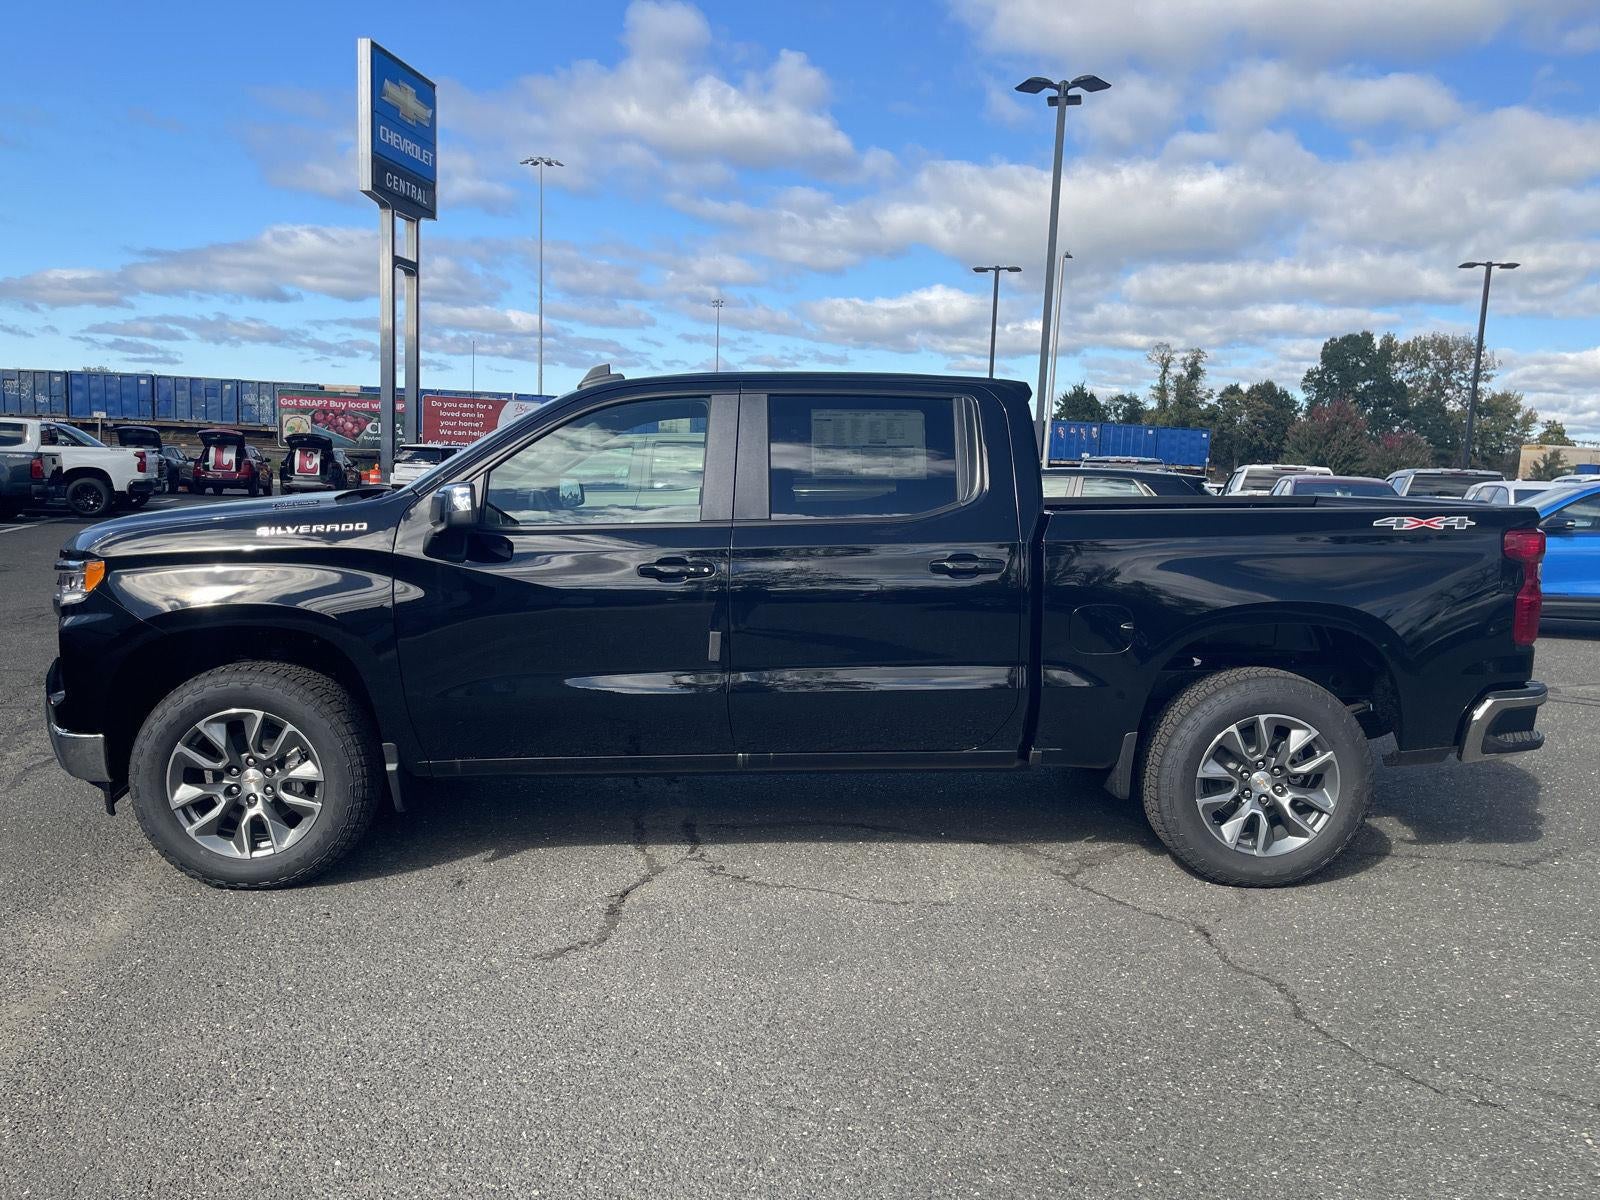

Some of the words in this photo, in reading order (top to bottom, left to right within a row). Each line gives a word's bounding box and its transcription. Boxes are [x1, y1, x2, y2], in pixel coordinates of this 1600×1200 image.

[379, 125, 433, 167] CHEVROLET
[386, 172, 428, 205] CENTRAL
[280, 398, 297, 406] Got
[299, 399, 328, 407] SNAP?
[330, 400, 346, 410] Buy
[348, 400, 369, 409] local
[439, 410, 460, 418] loved
[439, 428, 452, 436] We
[255, 522, 368, 537] SILVERADO
